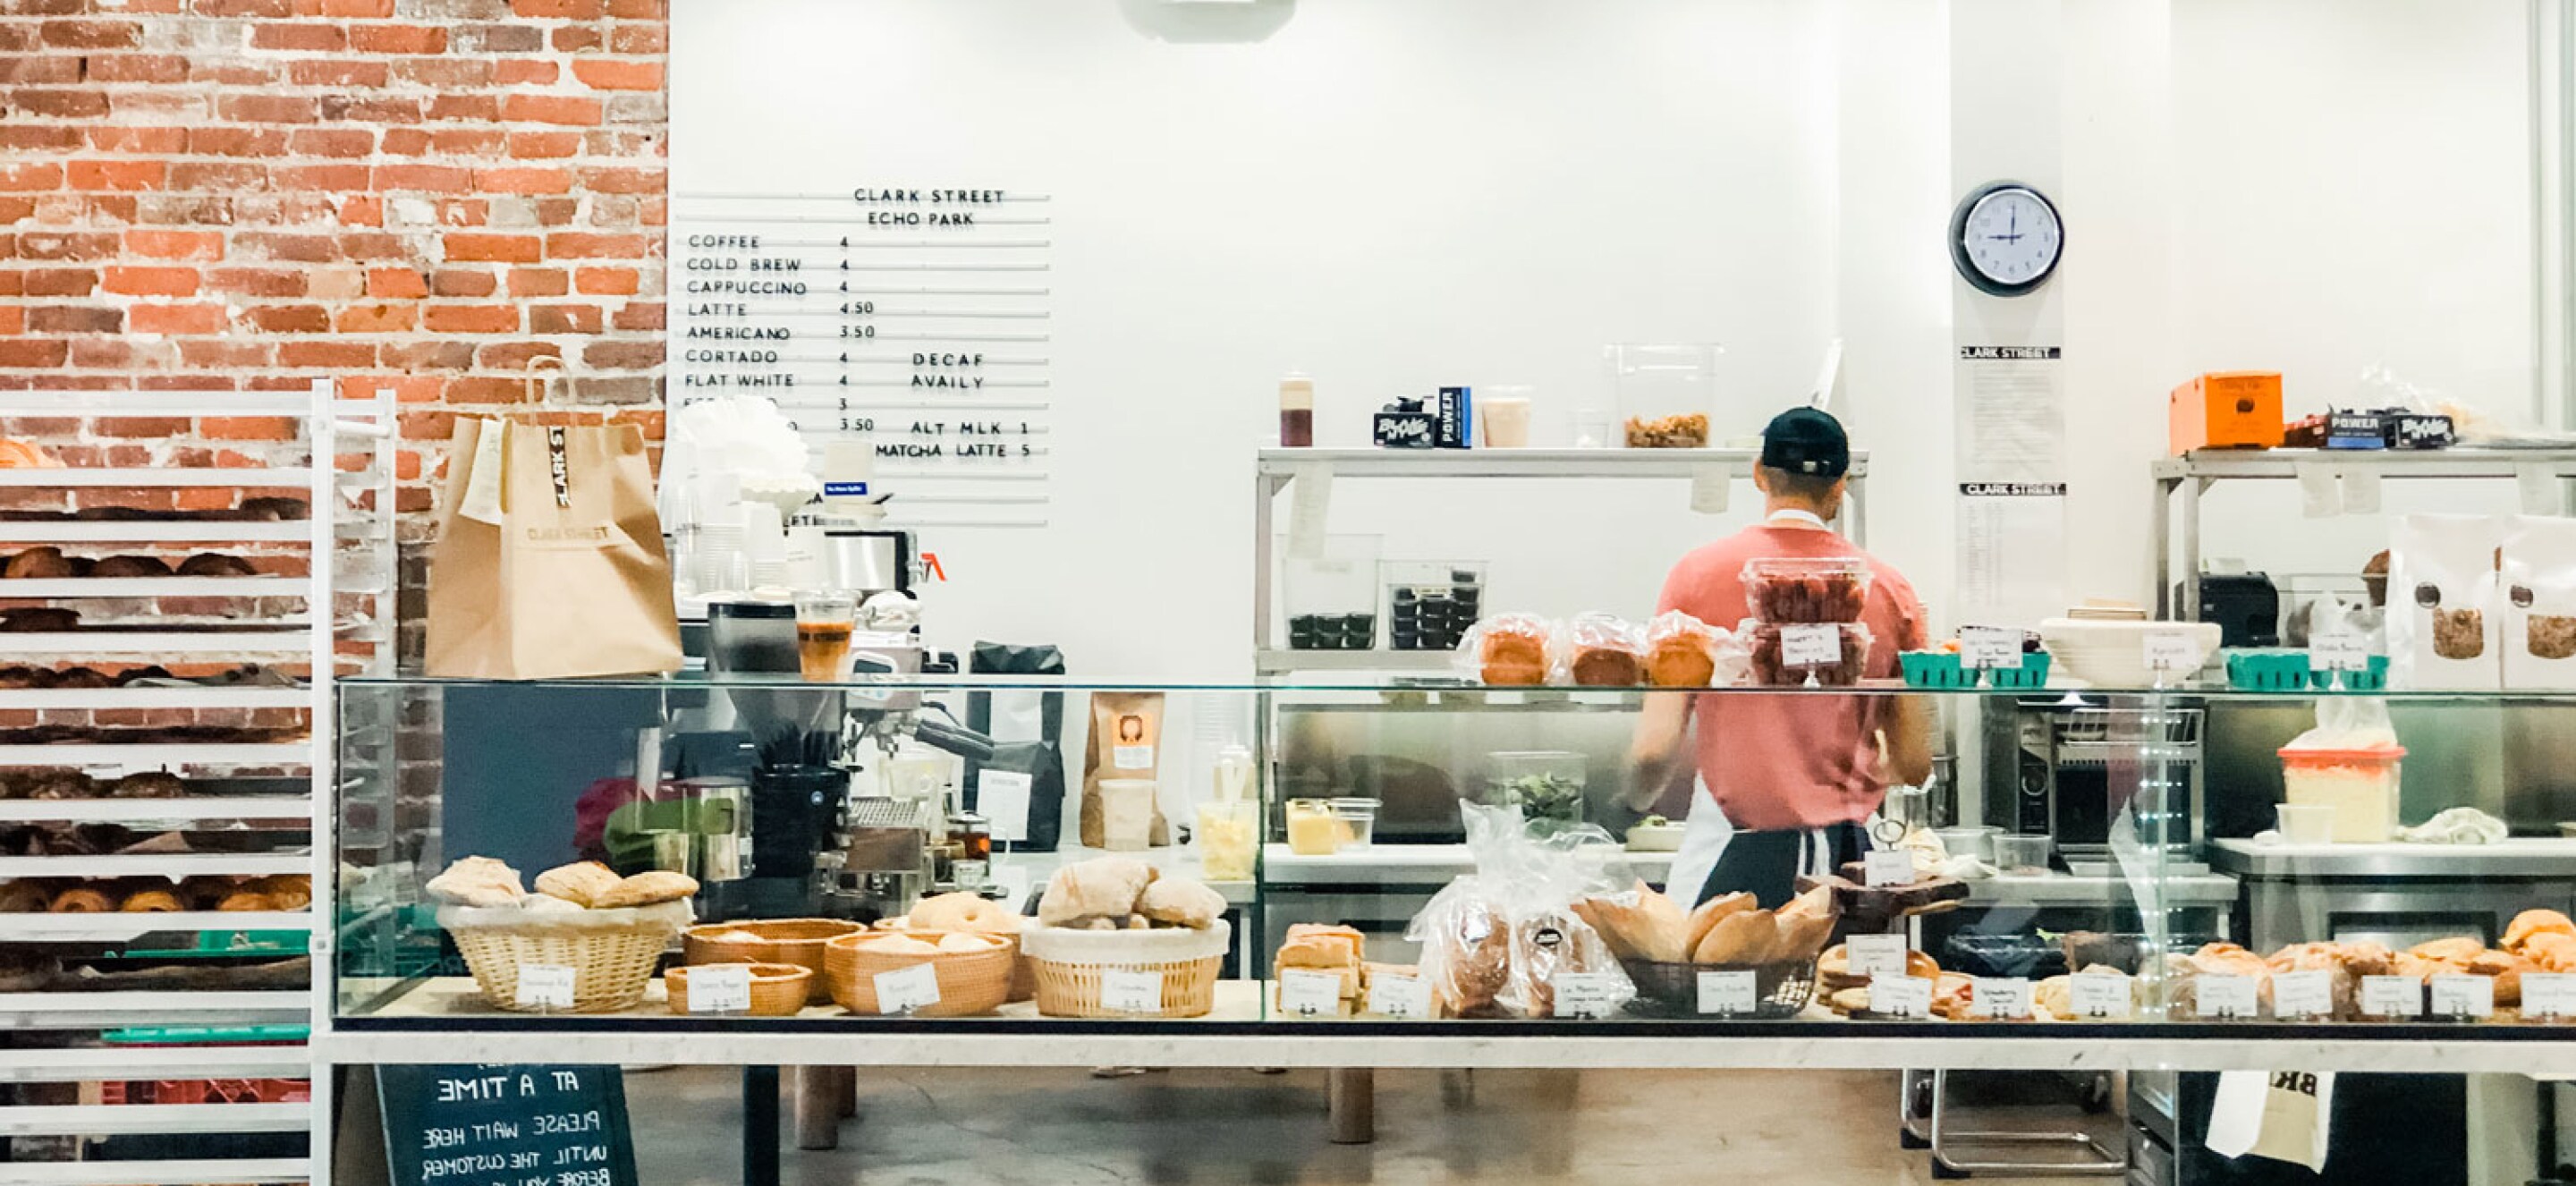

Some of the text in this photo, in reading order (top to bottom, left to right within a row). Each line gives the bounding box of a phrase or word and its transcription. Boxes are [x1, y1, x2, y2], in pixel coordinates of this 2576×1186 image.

[853, 189, 1005, 203] CLARK STREET
[868, 212, 975, 226] ECHO PARK
[688, 234, 850, 249] COFFEE 4
[686, 258, 850, 272] COLD BREW 4
[686, 281, 849, 296] CAPPUCCINO 4
[688, 301, 875, 318] LATTE 4.50
[686, 326, 876, 342] AMERICANO 3.50
[685, 350, 984, 368] CORTADO 4 DECAF
[685, 373, 985, 390] FLAT WHITE 4 AVAILY
[839, 398, 848, 411] 3
[840, 418, 1029, 436] 3.50 ALT MLK 1
[2331, 418, 2379, 428] POWER
[876, 445, 1030, 458] MATCHA LATTE 5
